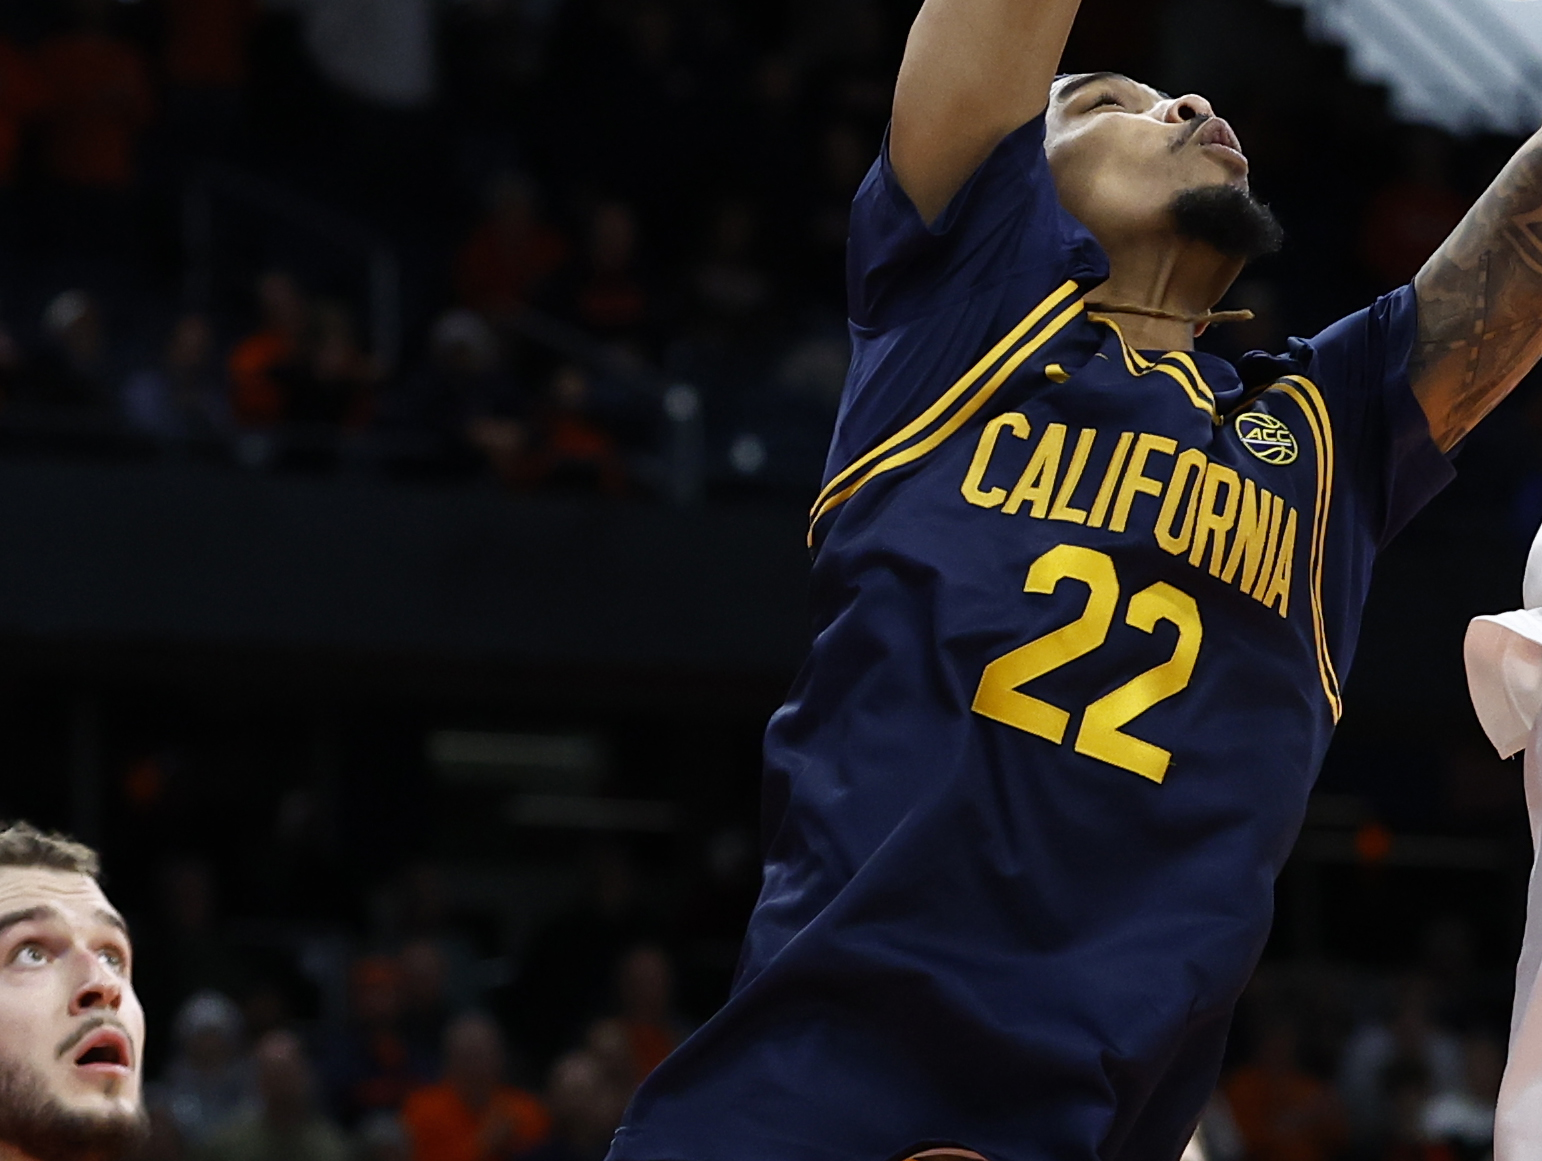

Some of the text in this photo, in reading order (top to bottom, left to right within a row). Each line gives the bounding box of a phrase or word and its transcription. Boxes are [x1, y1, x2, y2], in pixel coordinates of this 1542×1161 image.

[960, 412, 1298, 618] CALIFORNIA
[1245, 427, 1292, 443] ACC
[971, 543, 1203, 785] 22
